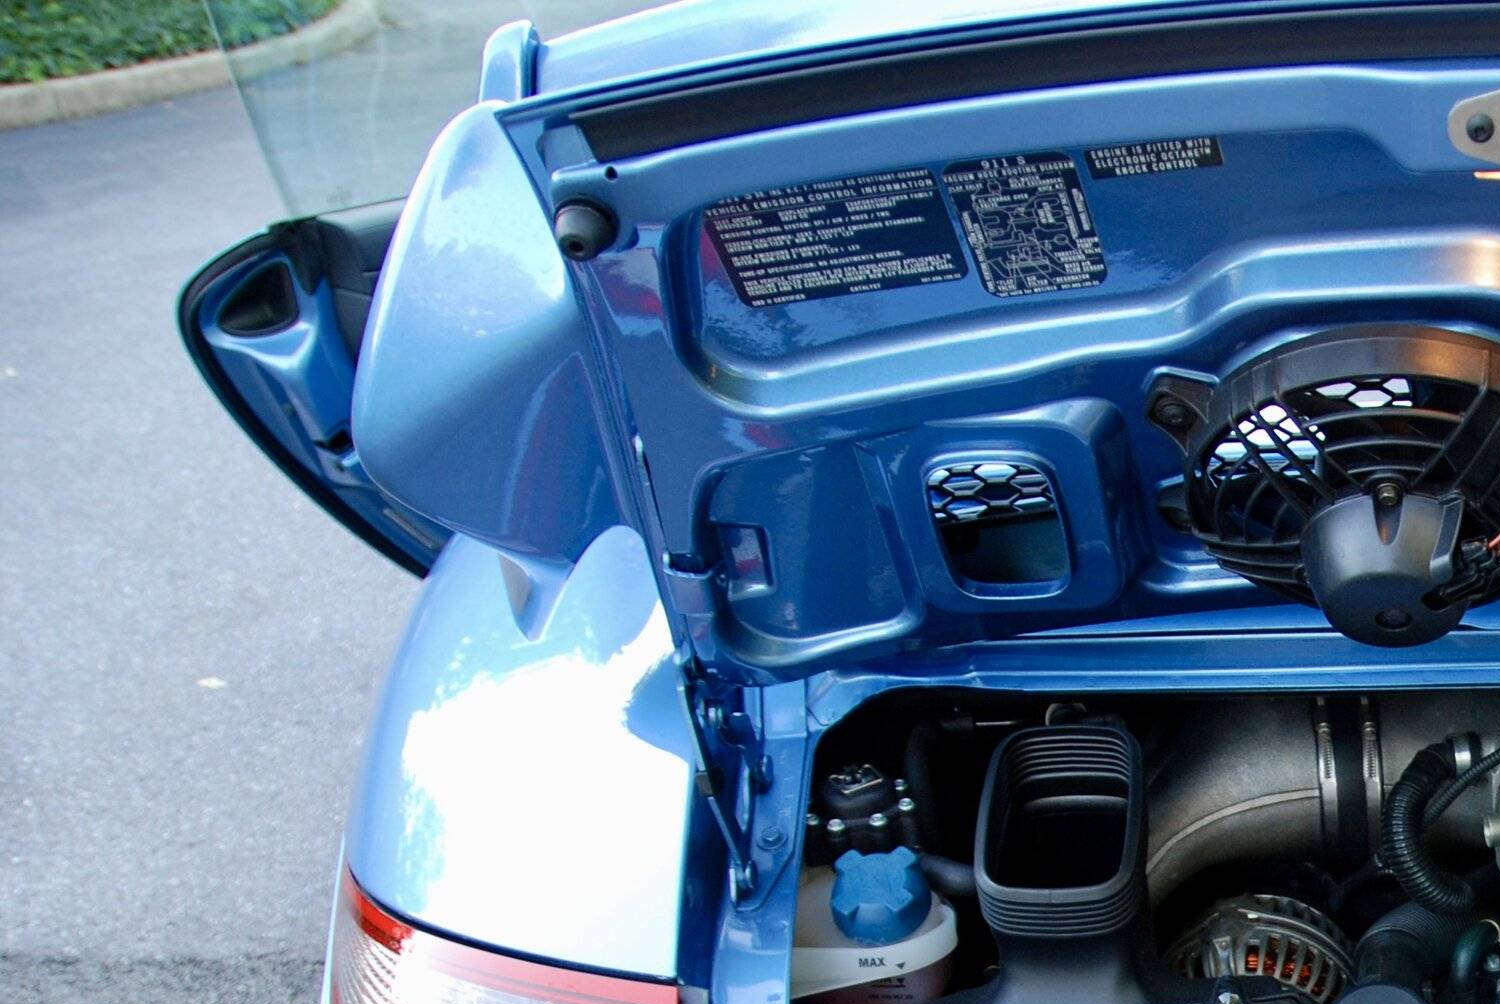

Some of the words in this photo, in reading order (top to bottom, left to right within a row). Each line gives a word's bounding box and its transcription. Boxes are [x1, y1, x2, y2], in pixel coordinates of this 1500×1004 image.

[1090, 146, 1128, 160] ENGINE
[1131, 145, 1143, 154] IS
[1146, 141, 1182, 153] FITTED
[1185, 138, 1212, 149] WITH
[980, 158, 1008, 170] 911
[1016, 156, 1026, 166] S
[1094, 153, 1157, 169] ELECTRONIC
[1114, 164, 1149, 176] KNOCK
[1152, 158, 1198, 171] CONTROL
[942, 173, 975, 183] VACUUM
[977, 169, 999, 179] HOSE
[1001, 165, 1037, 176] ROUTING
[1039, 161, 1075, 172] DIAGRAM
[705, 203, 750, 217] VEHICLE
[753, 196, 805, 210] EMISSION
[808, 189, 857, 202] CONTROL
[860, 179, 934, 195] INFORMATION
[858, 957, 886, 968] MAX
